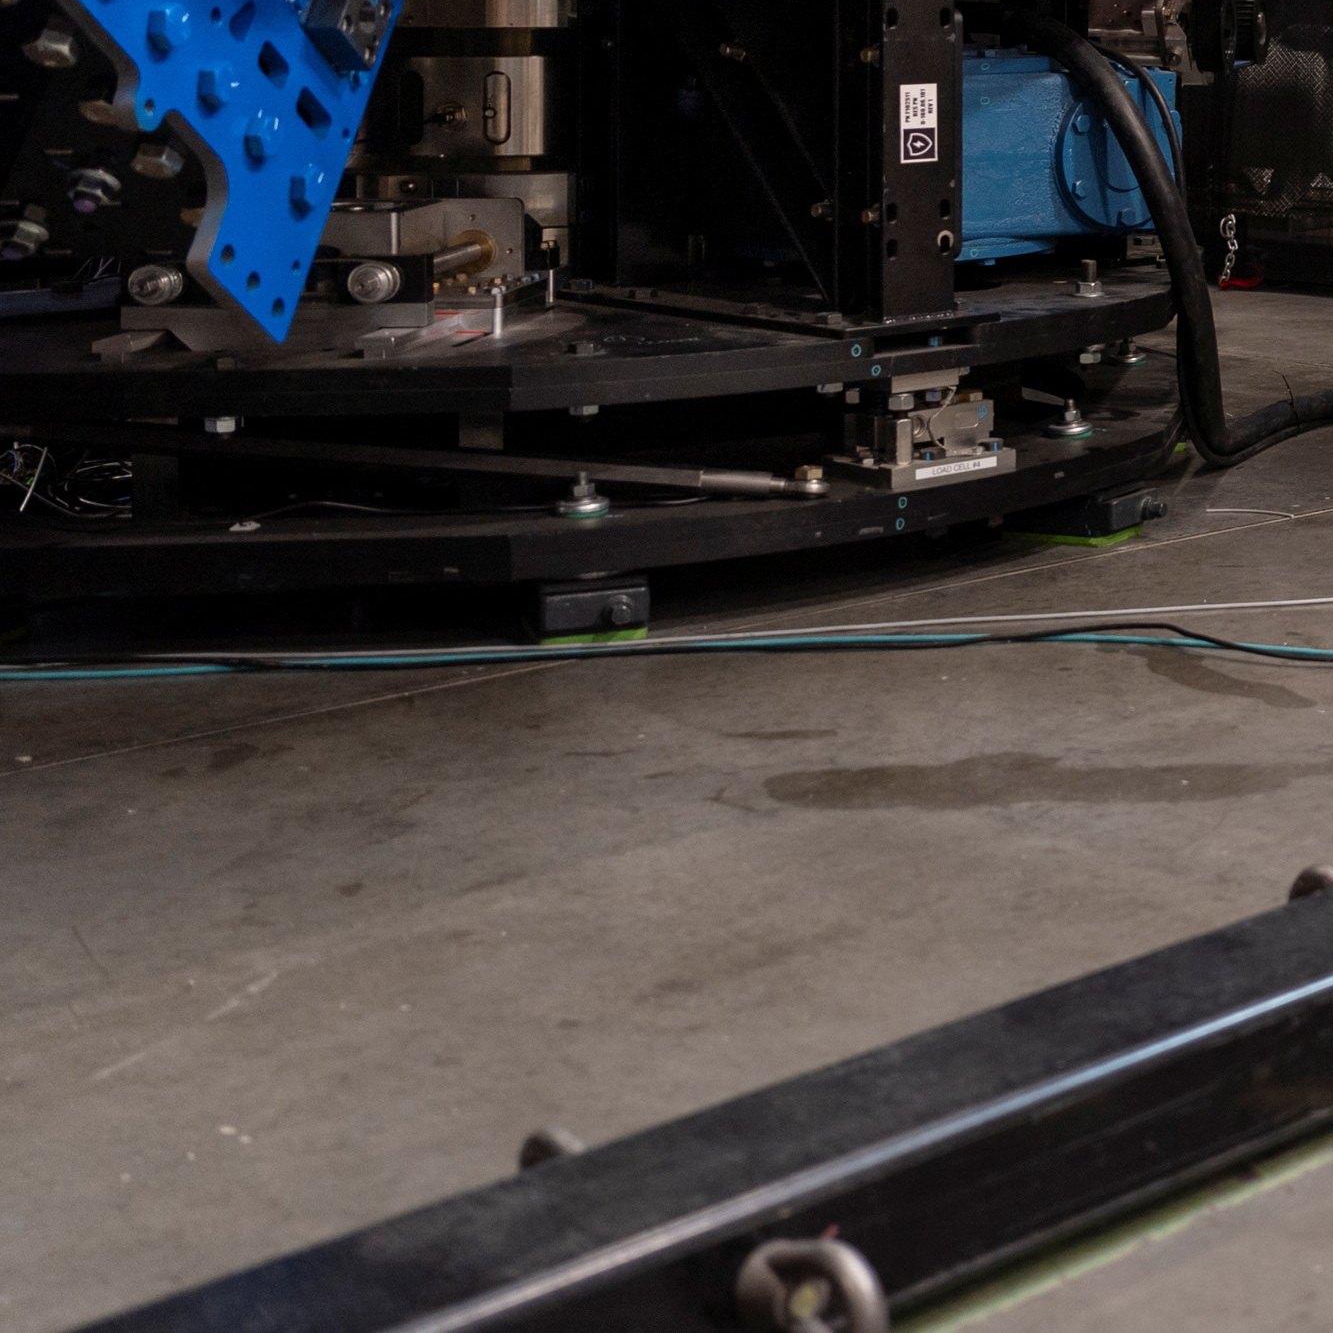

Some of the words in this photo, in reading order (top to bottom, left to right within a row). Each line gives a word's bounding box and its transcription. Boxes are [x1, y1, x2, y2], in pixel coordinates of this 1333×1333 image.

[932, 466, 952, 476] LOAD
[953, 462, 971, 472] CELL
[973, 460, 981, 468] #4
